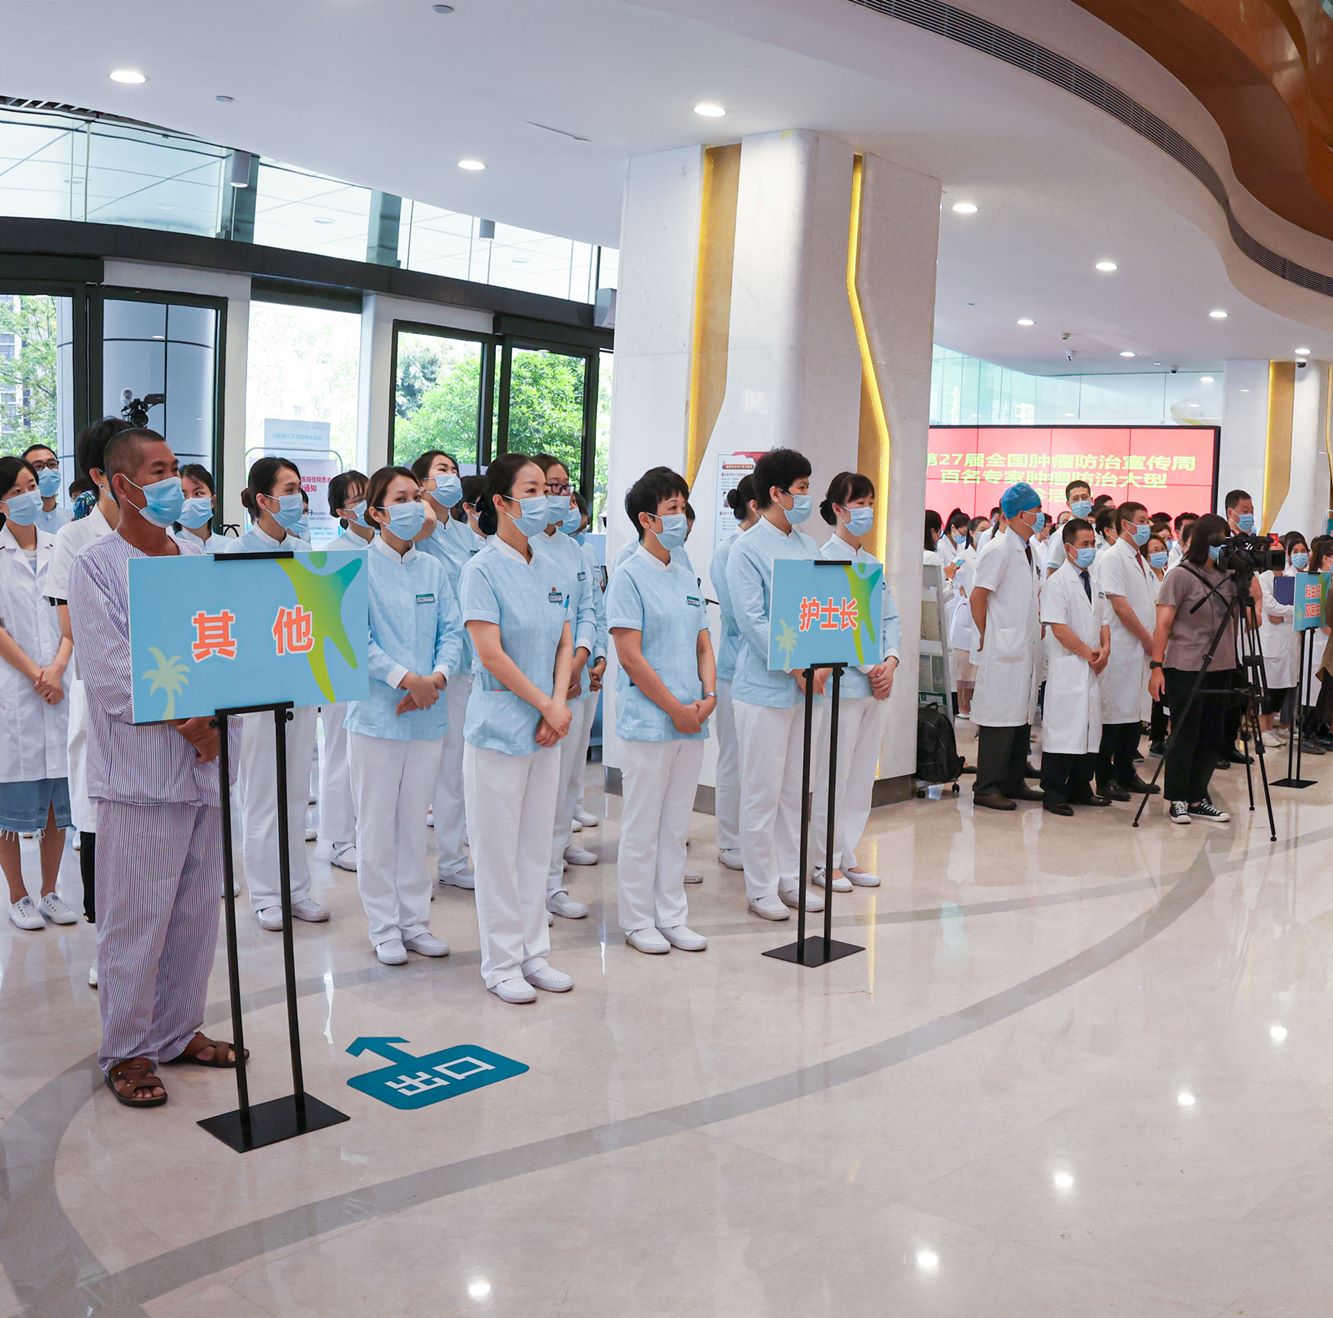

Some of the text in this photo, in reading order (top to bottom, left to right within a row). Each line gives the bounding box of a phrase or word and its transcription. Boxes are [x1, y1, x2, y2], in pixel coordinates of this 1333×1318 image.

[191, 604, 315, 663] 其他
[799, 596, 859, 632] 护士长
[384, 1056, 496, 1096] 出口
